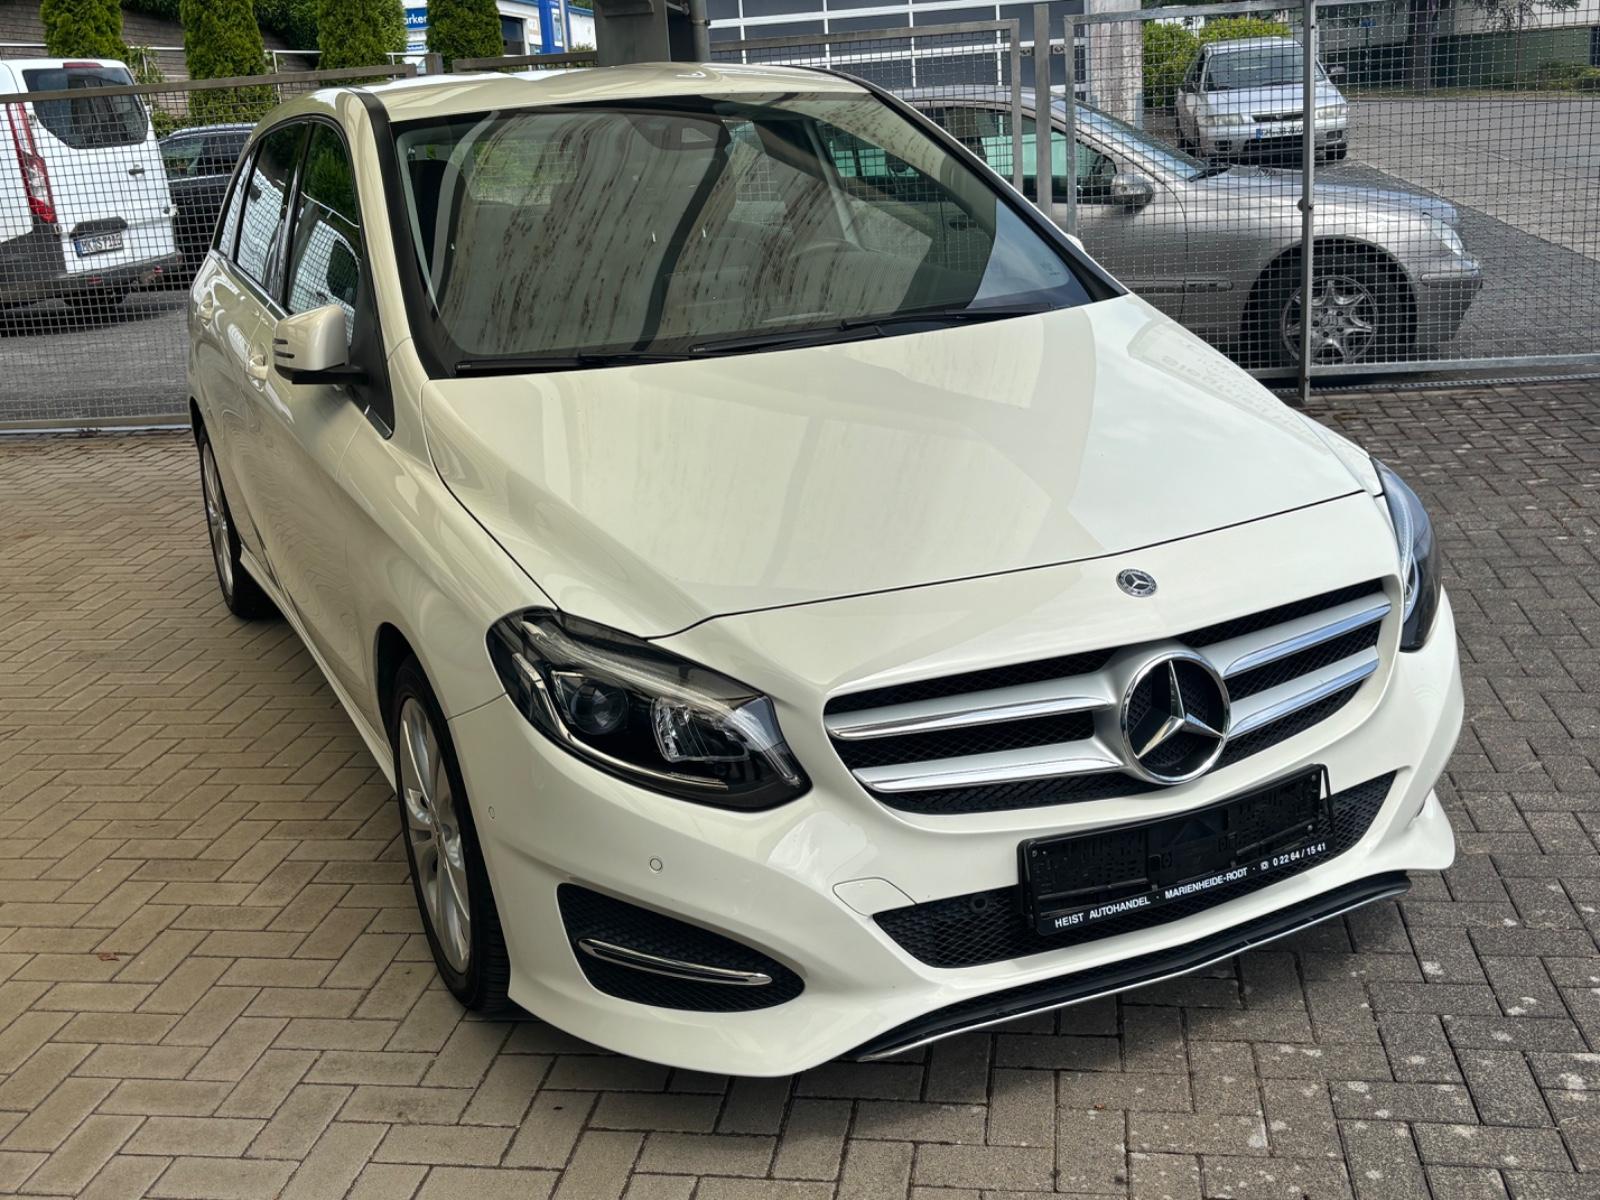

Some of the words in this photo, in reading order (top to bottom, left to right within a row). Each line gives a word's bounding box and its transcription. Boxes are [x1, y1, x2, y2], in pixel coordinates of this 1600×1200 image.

[1054, 912, 1085, 929] HEIST
[1089, 896, 1151, 919] AUTOHANDEL
[1164, 866, 1248, 899] MARIENHEIDE-RODT
